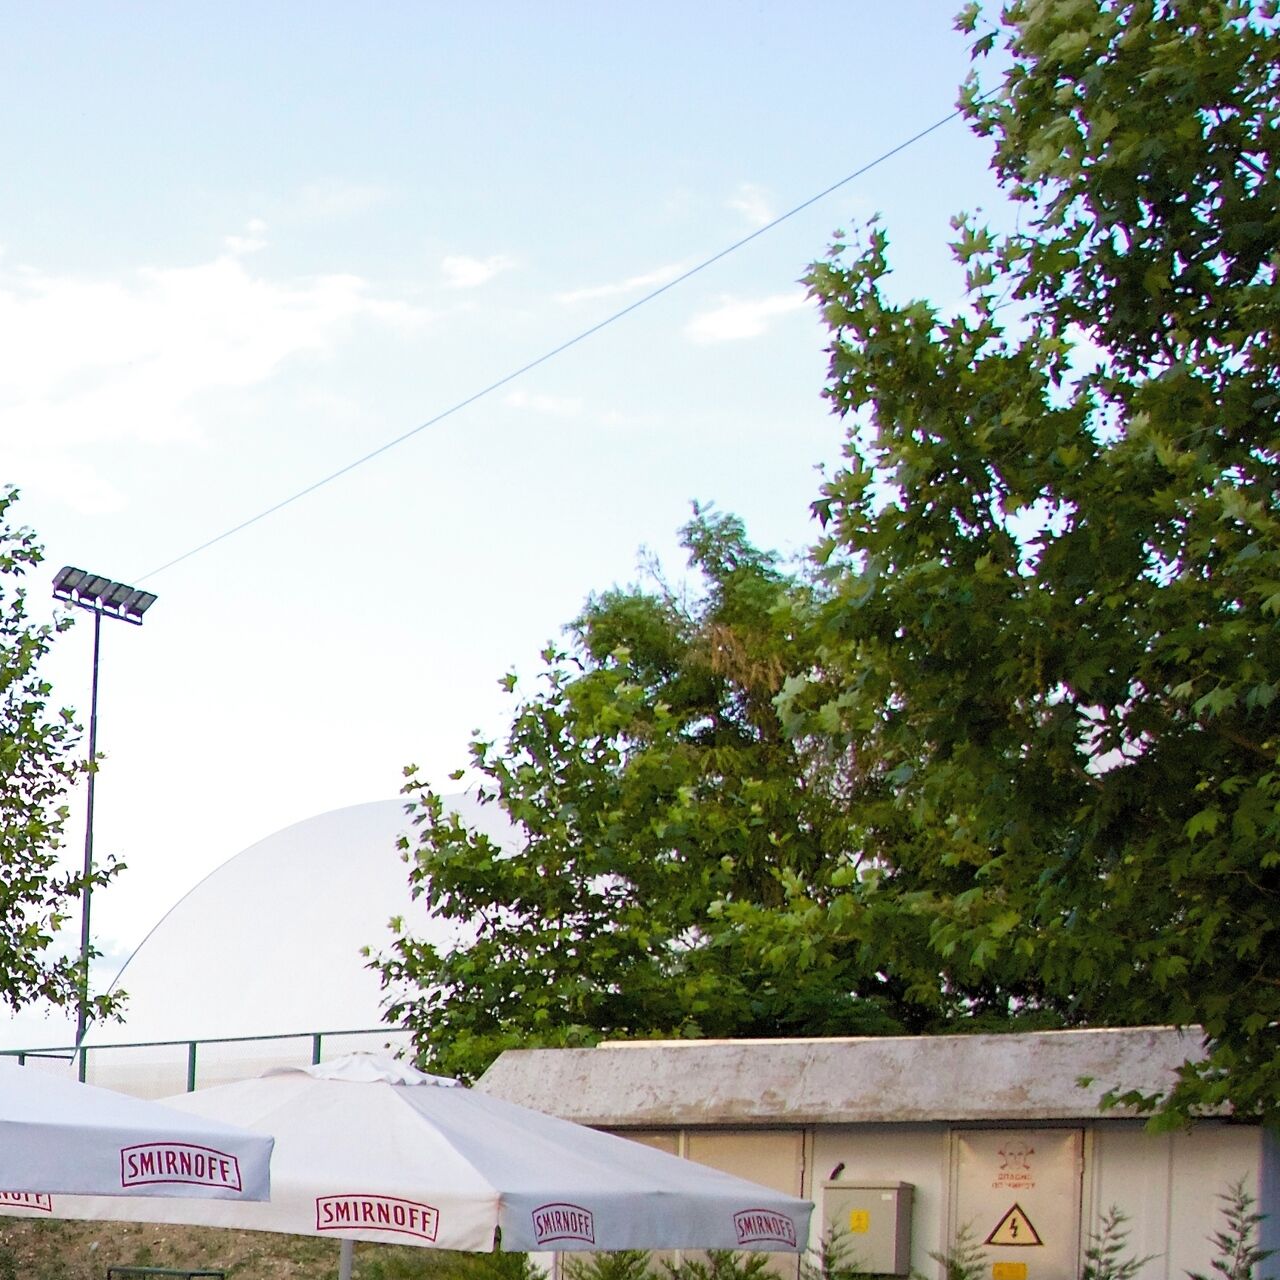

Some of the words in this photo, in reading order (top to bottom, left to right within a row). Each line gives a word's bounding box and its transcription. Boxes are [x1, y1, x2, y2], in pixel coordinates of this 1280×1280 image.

[127, 1150, 230, 1182] SMIRNOFF
[322, 1201, 432, 1232] SMIRNOFF
[535, 1209, 590, 1237] SMIRNOFF
[737, 1214, 794, 1240] SMIRNOFF
